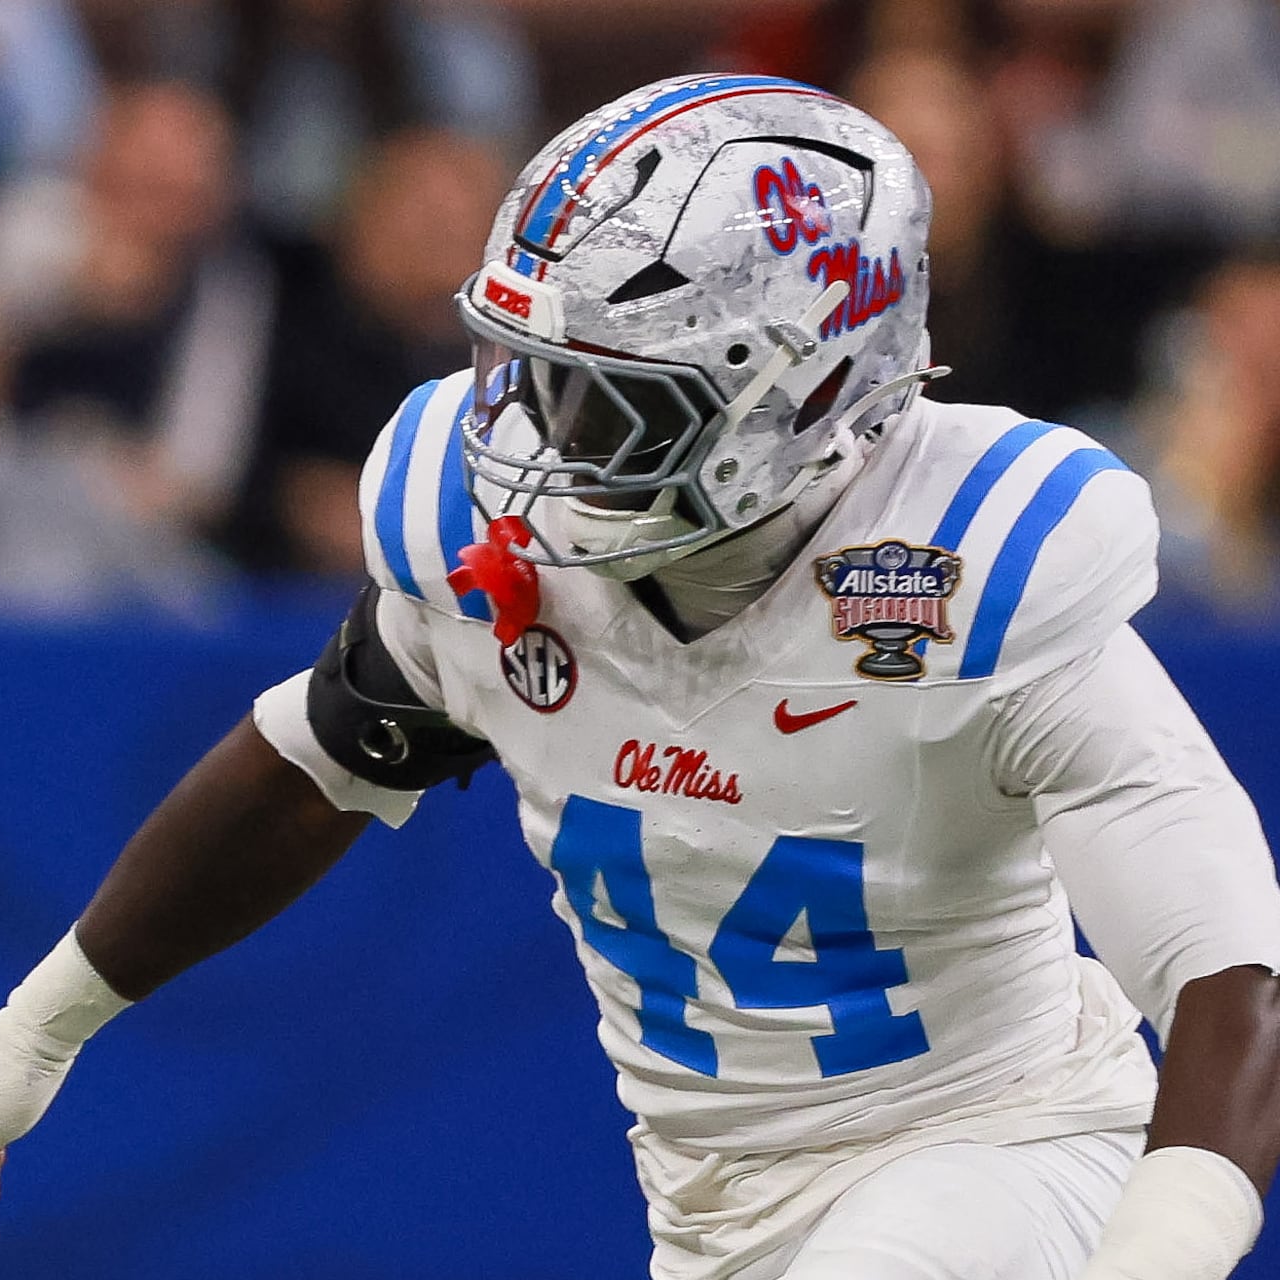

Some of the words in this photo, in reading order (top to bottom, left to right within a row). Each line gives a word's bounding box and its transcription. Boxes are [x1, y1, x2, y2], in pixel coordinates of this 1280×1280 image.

[503, 630, 569, 707] SEC
[614, 739, 660, 793] Ole
[663, 745, 743, 804] Miss
[551, 794, 930, 1079] 44
